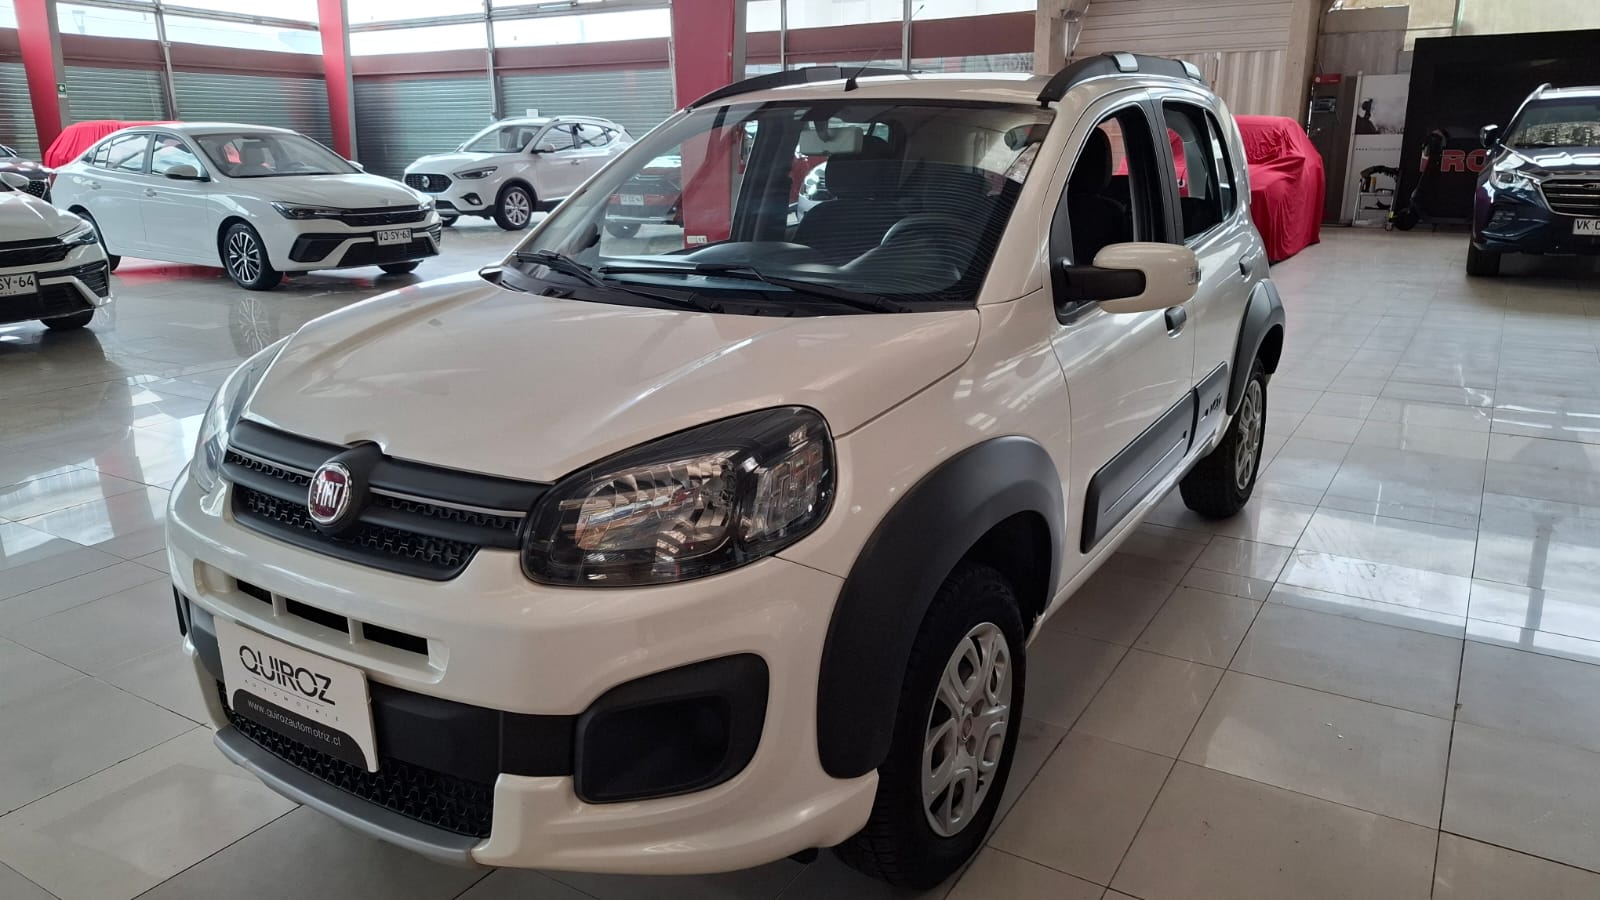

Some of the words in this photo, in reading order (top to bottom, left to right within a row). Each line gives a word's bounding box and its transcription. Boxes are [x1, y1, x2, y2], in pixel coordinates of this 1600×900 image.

[314, 477, 344, 508] FIAT
[239, 645, 336, 705] QUIROZ
[248, 700, 342, 746] www.quirozautomotriz.cl
